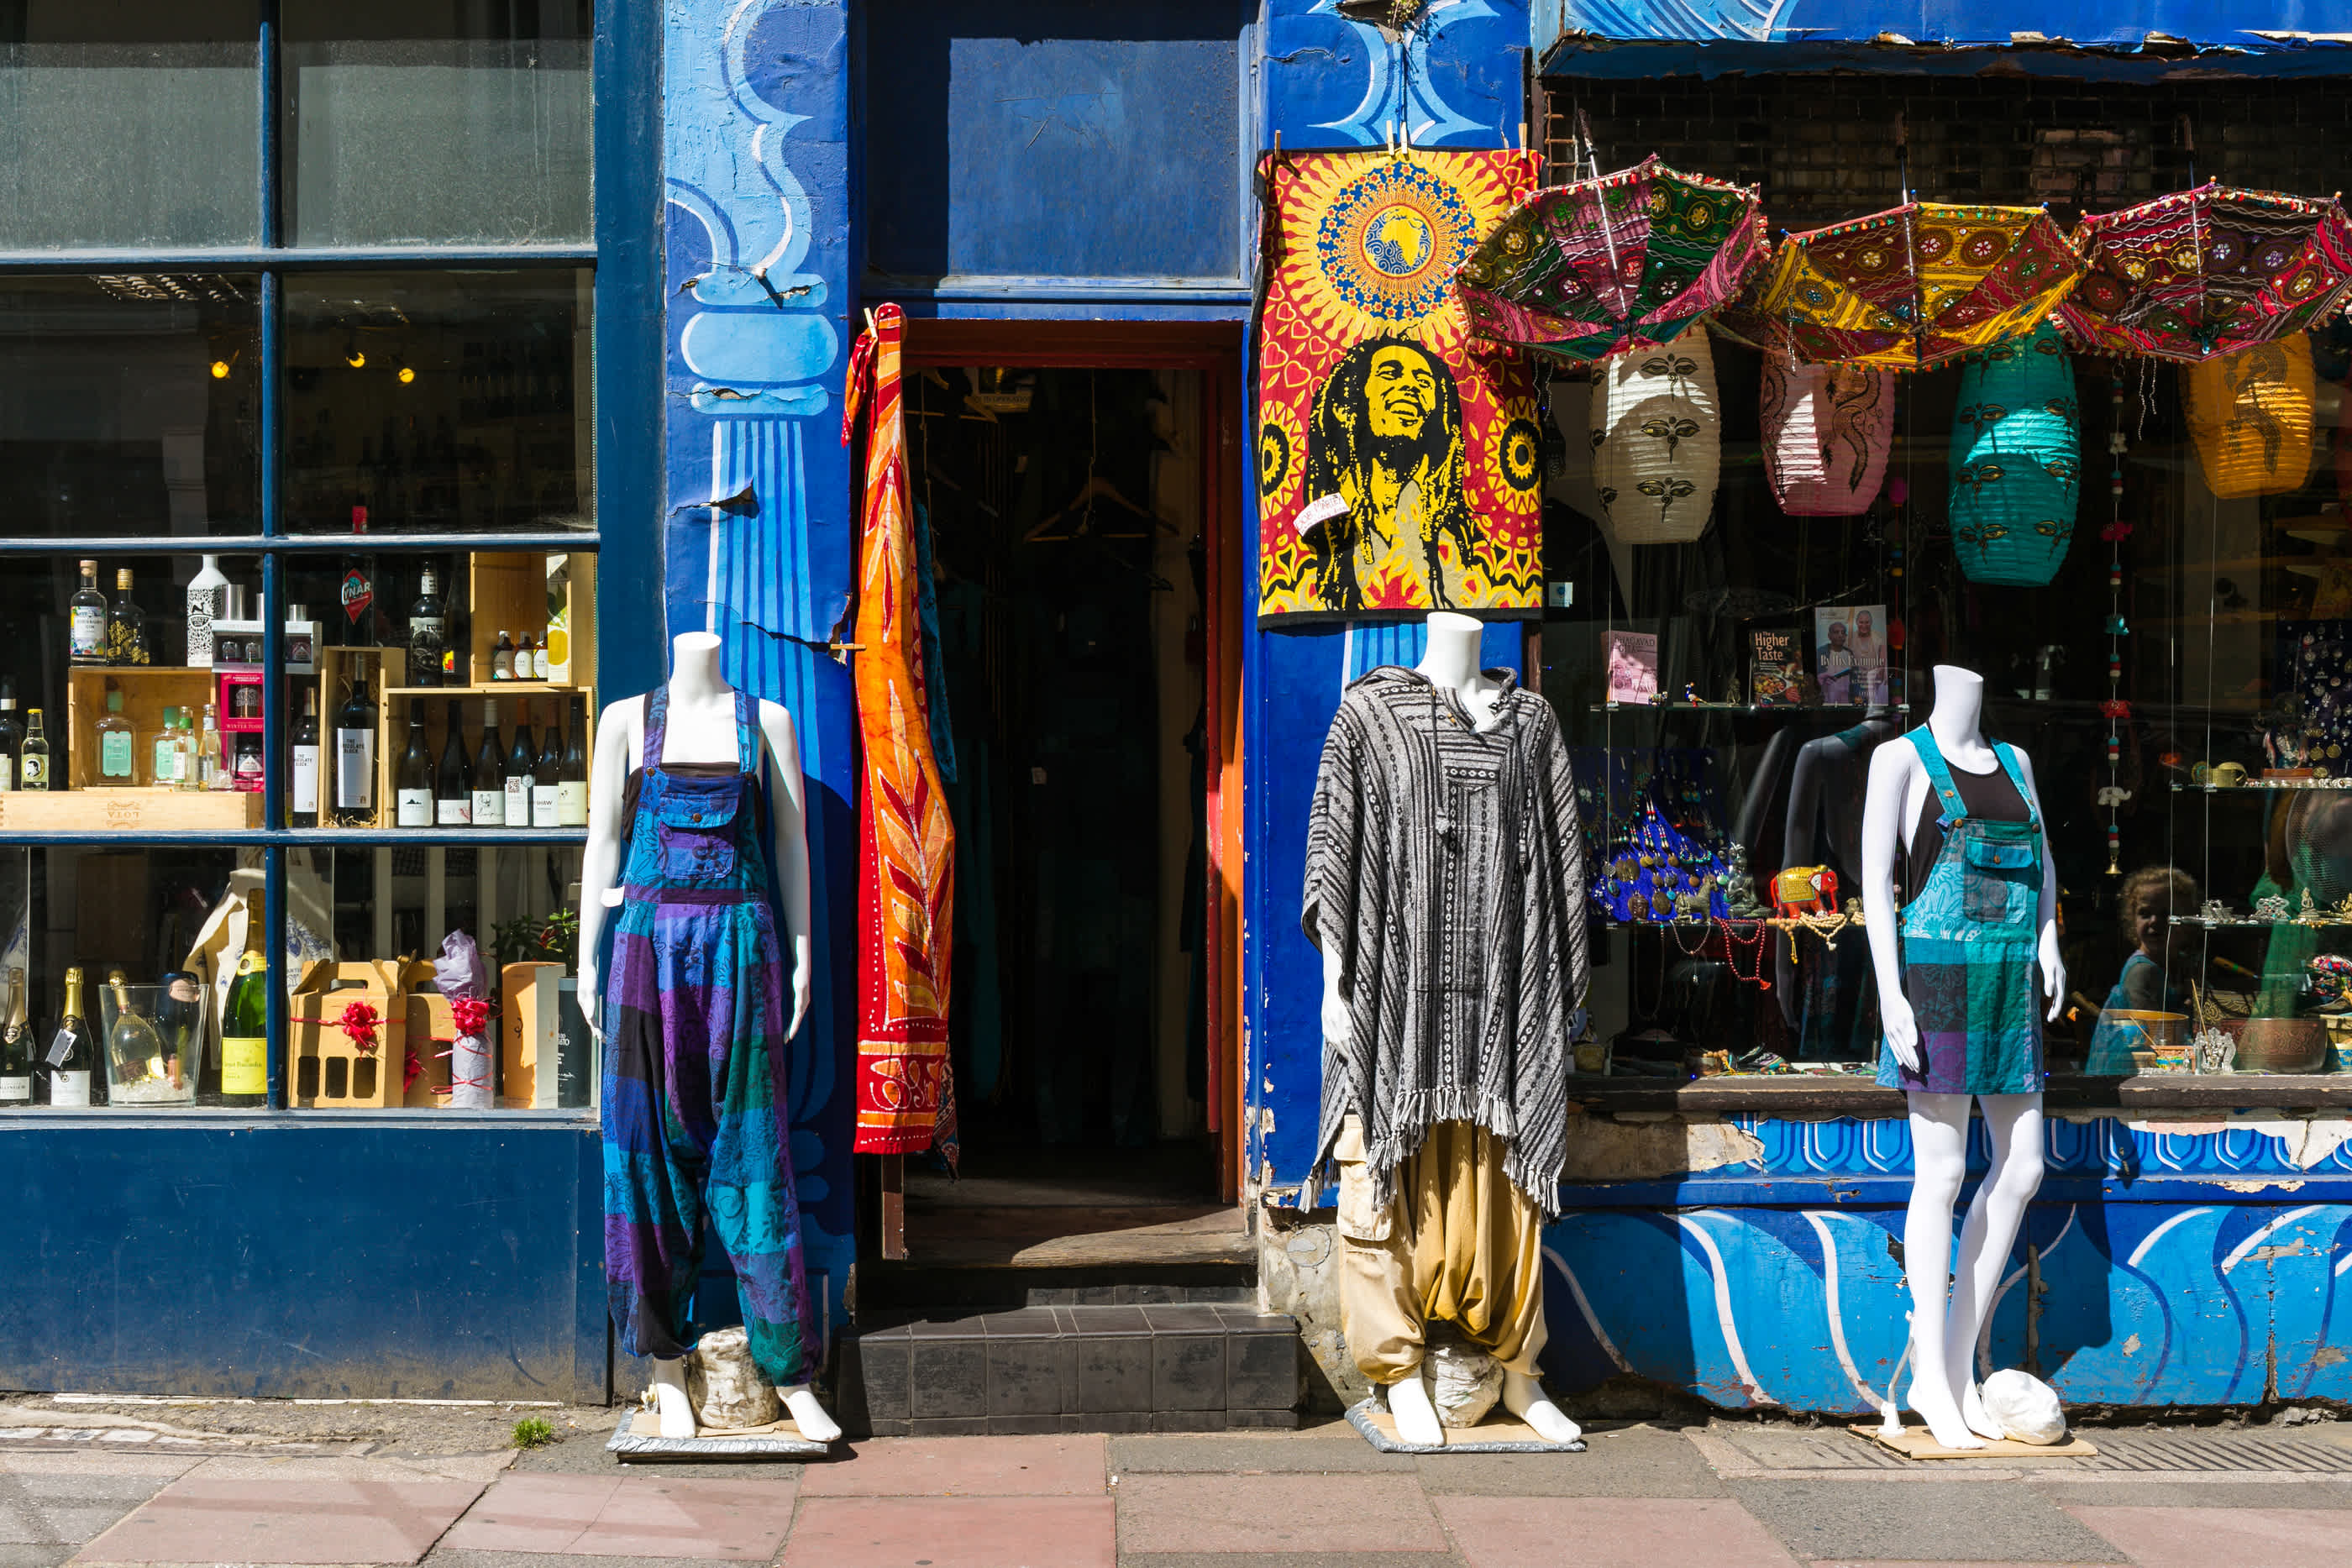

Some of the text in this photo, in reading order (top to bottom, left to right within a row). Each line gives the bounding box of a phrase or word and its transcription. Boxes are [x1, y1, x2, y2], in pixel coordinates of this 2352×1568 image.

[342, 581, 370, 606] CYNAR
[1755, 632, 1789, 651] Higher
[1756, 647, 1783, 661] Taste
[1820, 654, 1884, 669] By His Example
